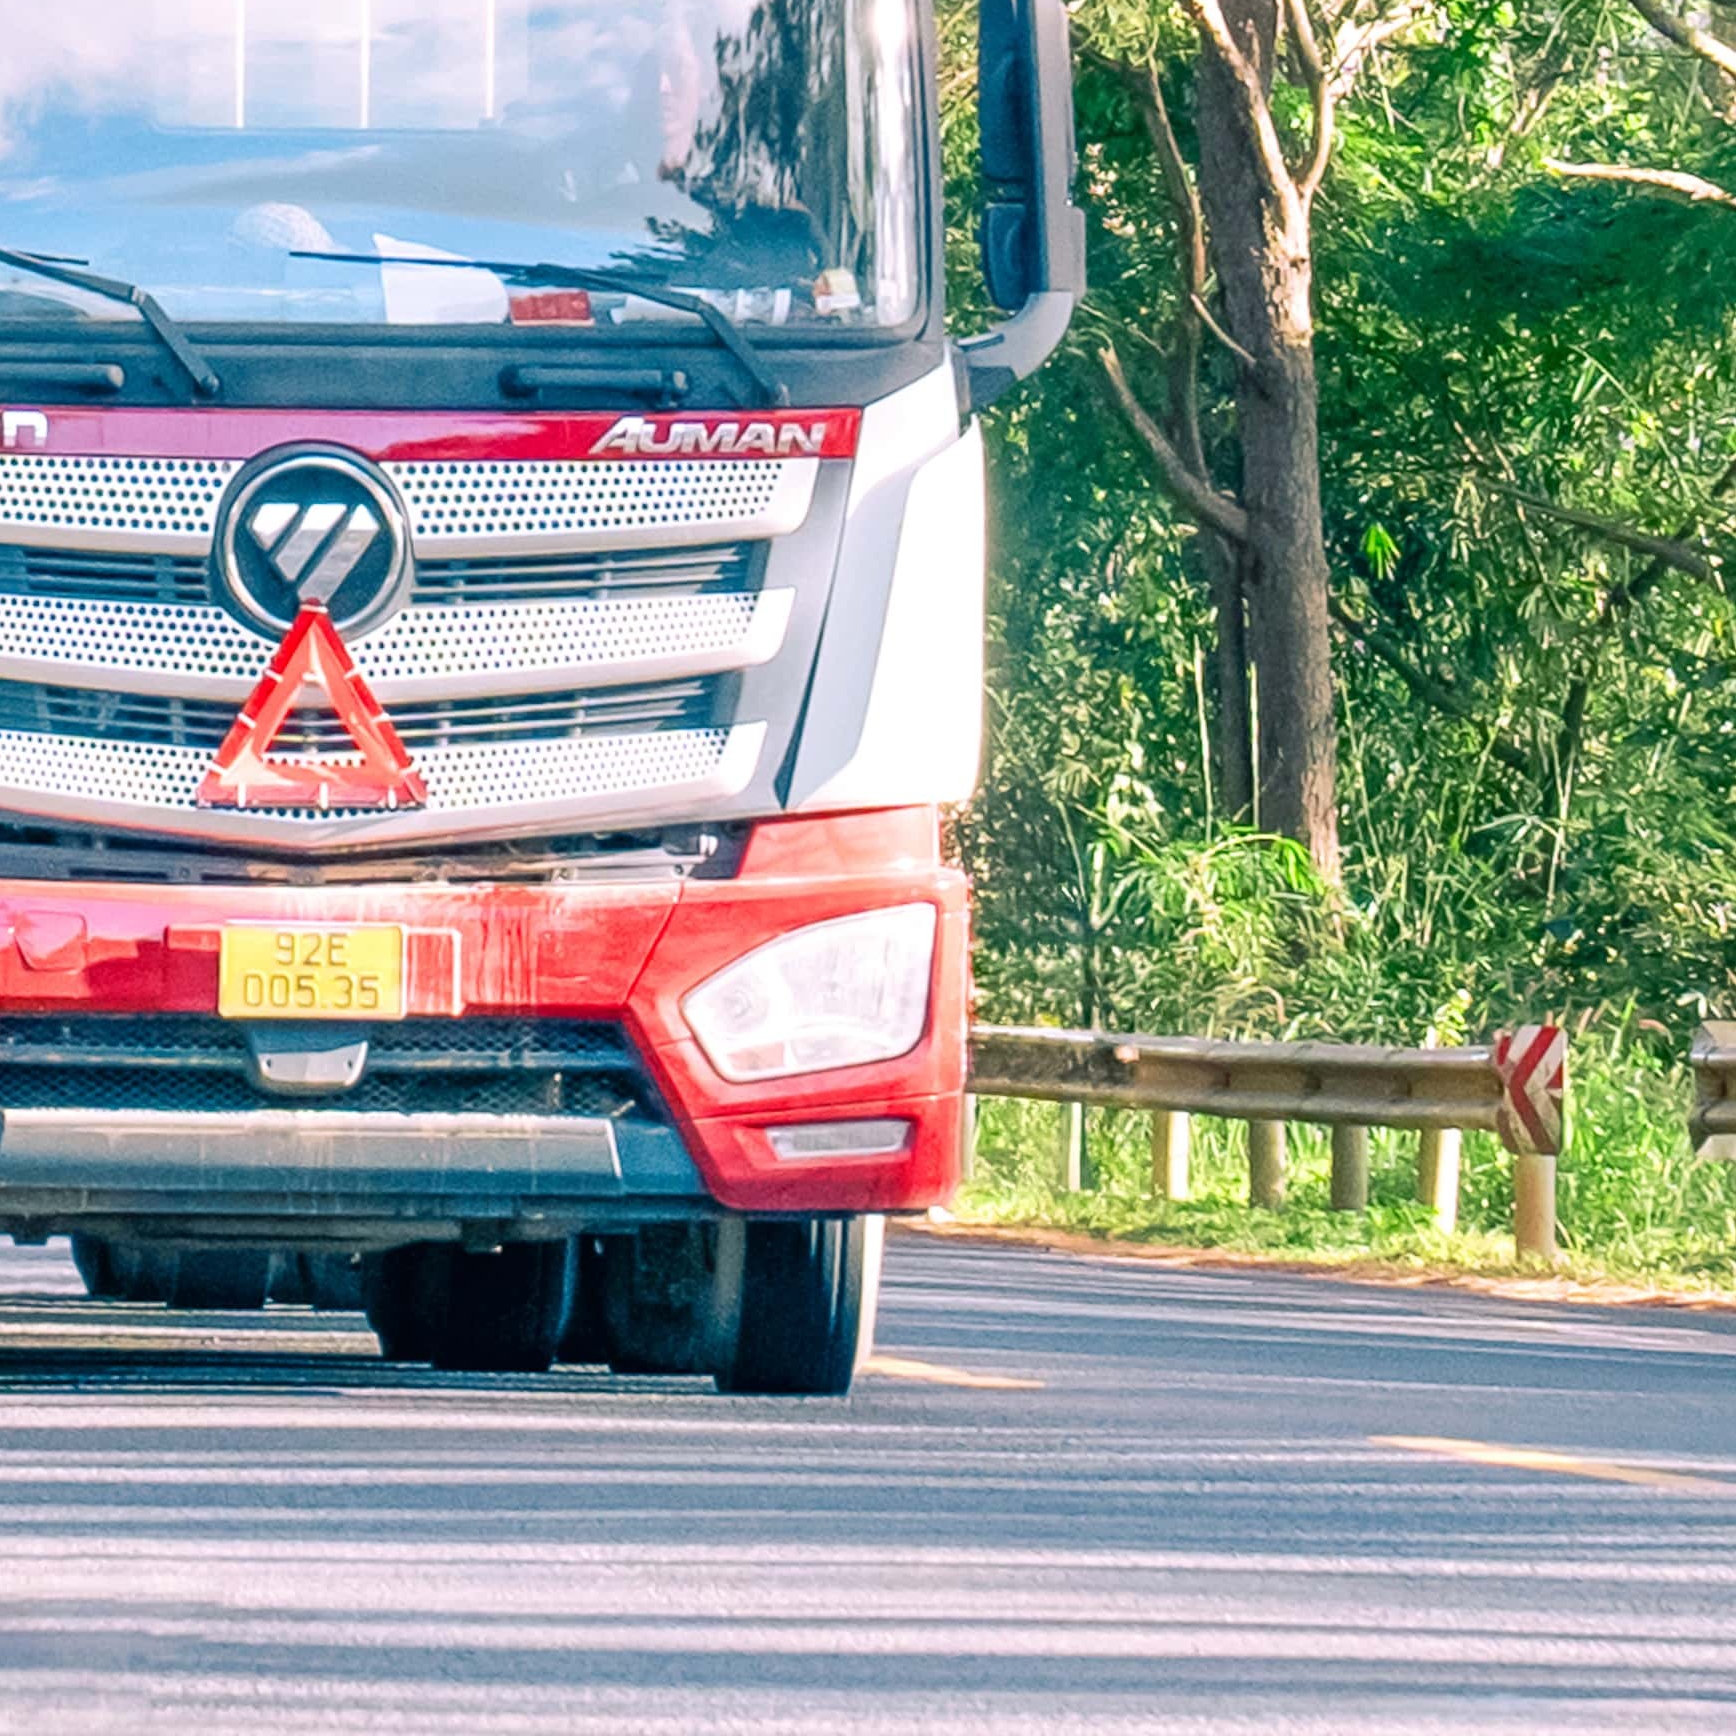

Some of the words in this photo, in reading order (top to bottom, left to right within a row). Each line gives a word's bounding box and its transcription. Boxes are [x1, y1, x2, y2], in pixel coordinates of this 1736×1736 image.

[588, 416, 828, 454] AUMAN
[276, 932, 348, 967] 92E
[244, 973, 379, 1009] 005.35
